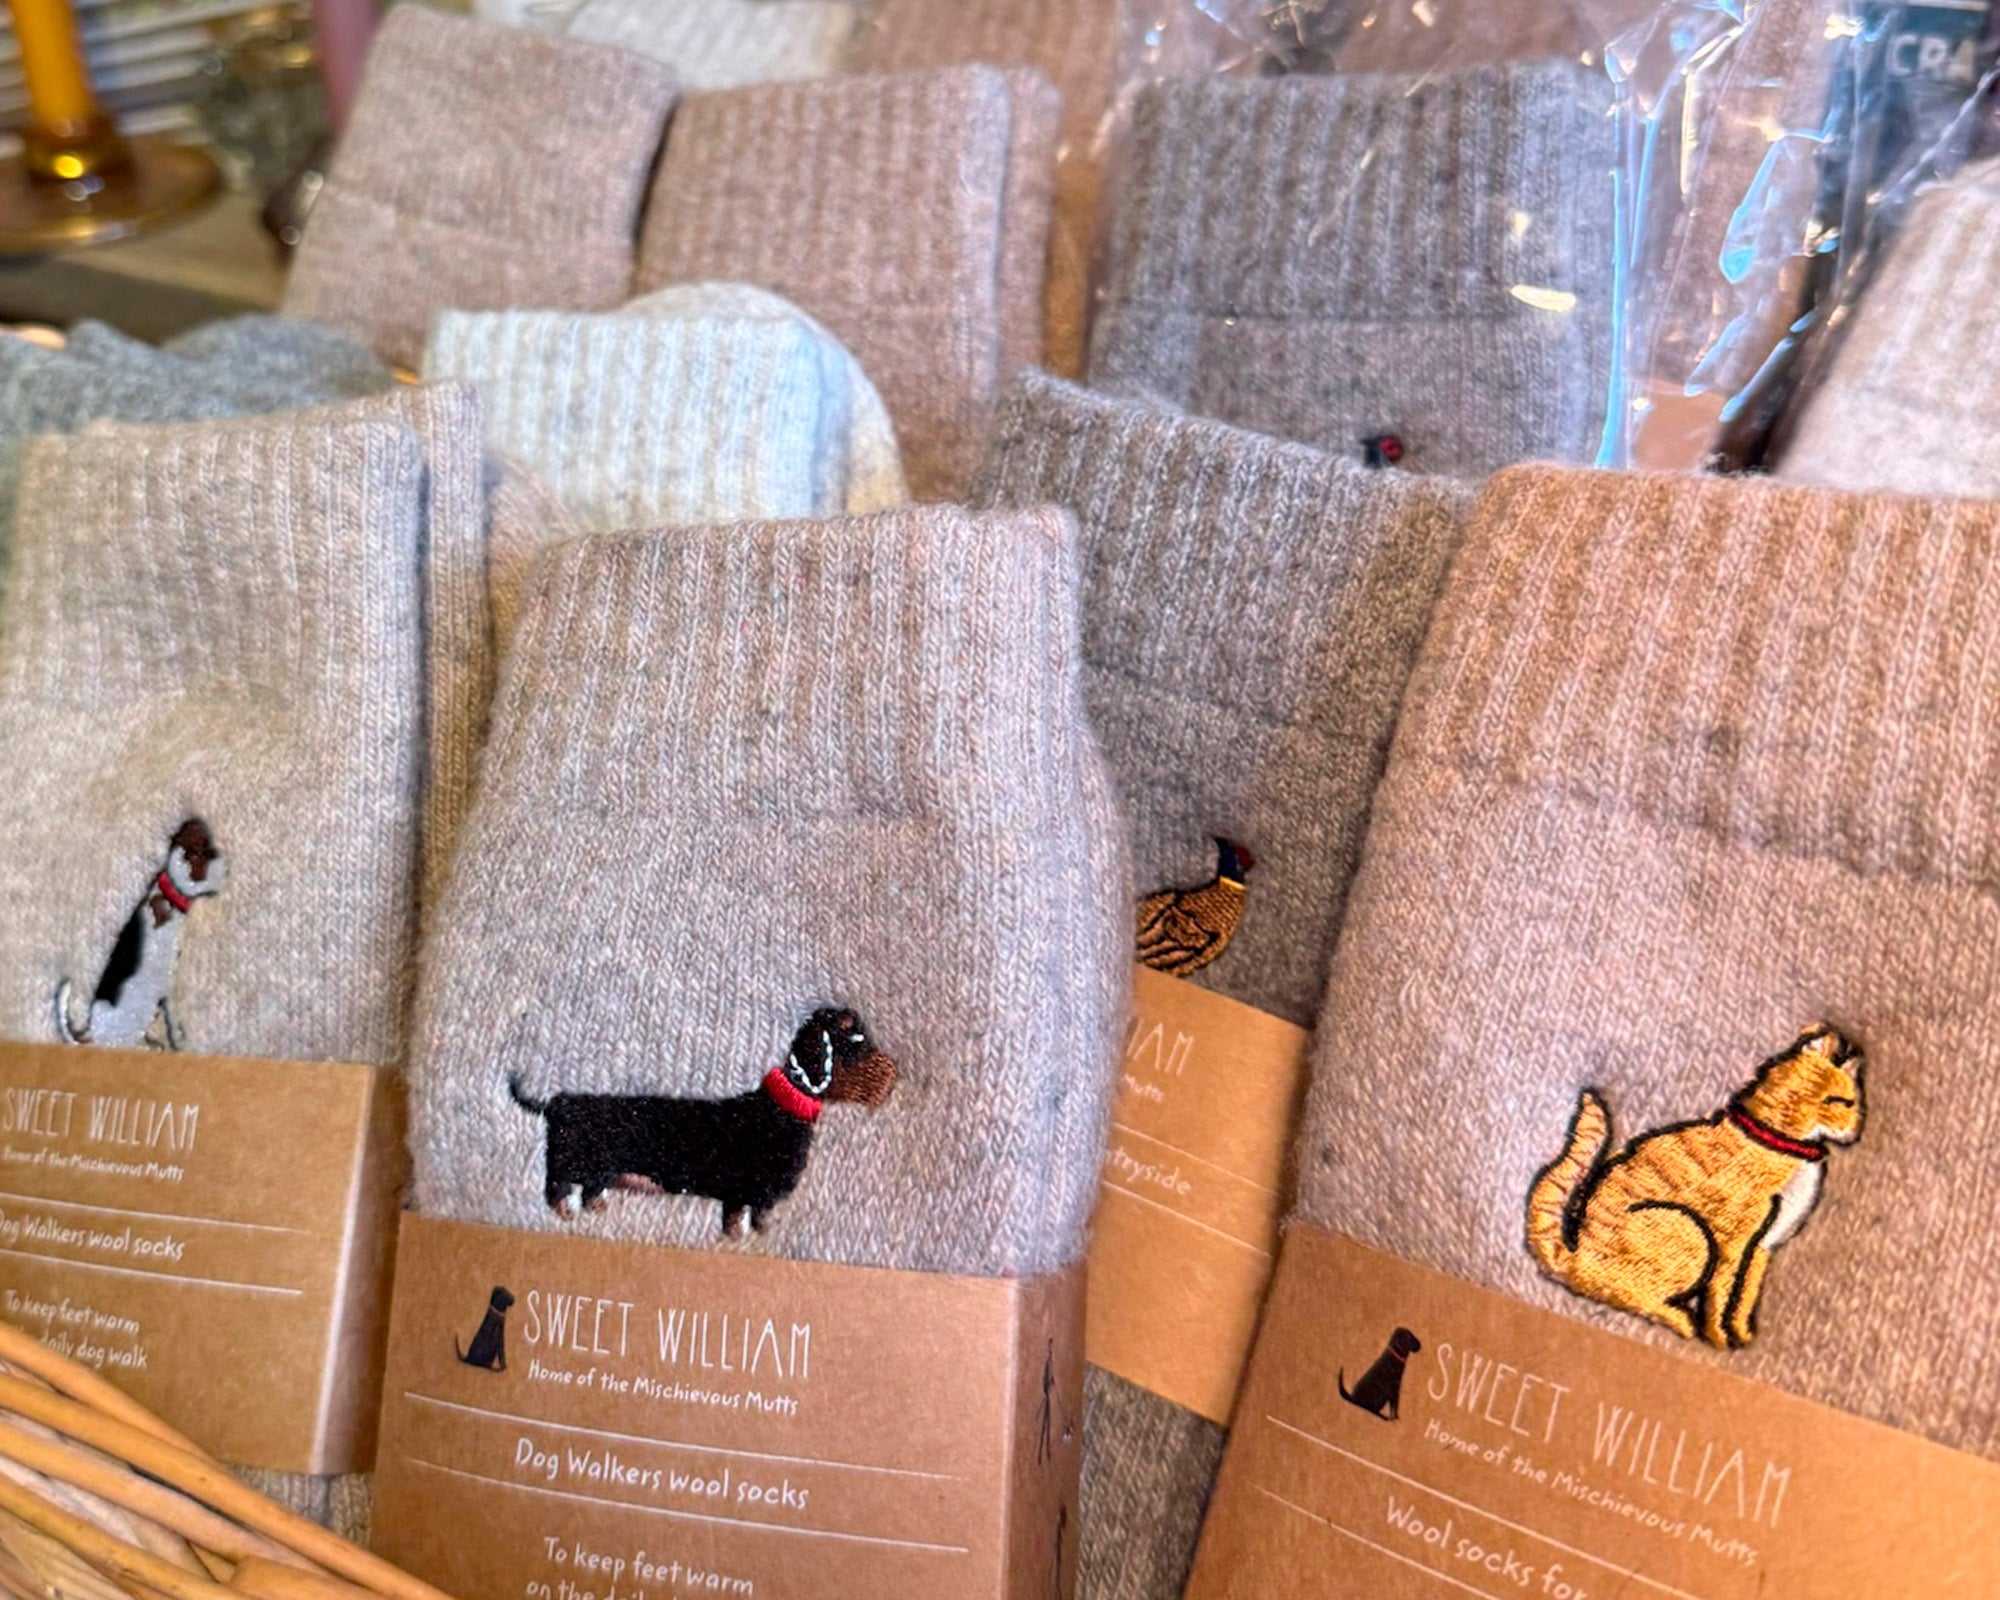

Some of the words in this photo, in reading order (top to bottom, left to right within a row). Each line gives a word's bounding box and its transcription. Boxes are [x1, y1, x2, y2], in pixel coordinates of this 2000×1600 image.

[3, 1087, 77, 1138] SWEET
[91, 1095, 200, 1152] WILLIAM
[33, 1147, 48, 1163] of
[69, 1153, 143, 1176] Mischievous
[145, 1161, 184, 1182] Mutts
[24, 1214, 87, 1248] Walkers
[88, 1226, 131, 1250] wool
[134, 1235, 186, 1261] socks
[5, 1289, 21, 1312] To
[21, 1295, 60, 1324] keep
[60, 1297, 93, 1324] feet
[93, 1311, 141, 1338] warm
[524, 1289, 635, 1358] SWEET
[658, 1307, 811, 1379] WILLIAM
[77, 1335, 106, 1369] dog
[109, 1343, 148, 1370] walk
[527, 1358, 573, 1384] Home
[576, 1366, 597, 1387] of
[600, 1372, 629, 1393] the
[632, 1376, 741, 1408] Mischievous
[744, 1391, 799, 1416] Mutts
[1427, 1342, 1571, 1444] SWEET
[1593, 1401, 1793, 1530] WILLIAM
[515, 1437, 560, 1480] Dog
[567, 1447, 663, 1491] Walkers
[669, 1469, 730, 1498] wool
[736, 1479, 811, 1510] socks
[1424, 1418, 1480, 1456] Home
[1483, 1444, 1511, 1465] of
[1512, 1454, 1548, 1484] the
[1550, 1471, 1687, 1539] Mischievous
[1688, 1523, 1759, 1568] Mutts
[544, 1536, 569, 1564] To
[574, 1542, 626, 1582] keep
[632, 1550, 682, 1584] feet
[686, 1567, 755, 1595] warm
[1386, 1495, 1453, 1549] Wool
[1453, 1538, 1535, 1588] socks
[1541, 1563, 1588, 1600] for
[526, 1580, 551, 1600] on
[557, 1579, 595, 1600] the
